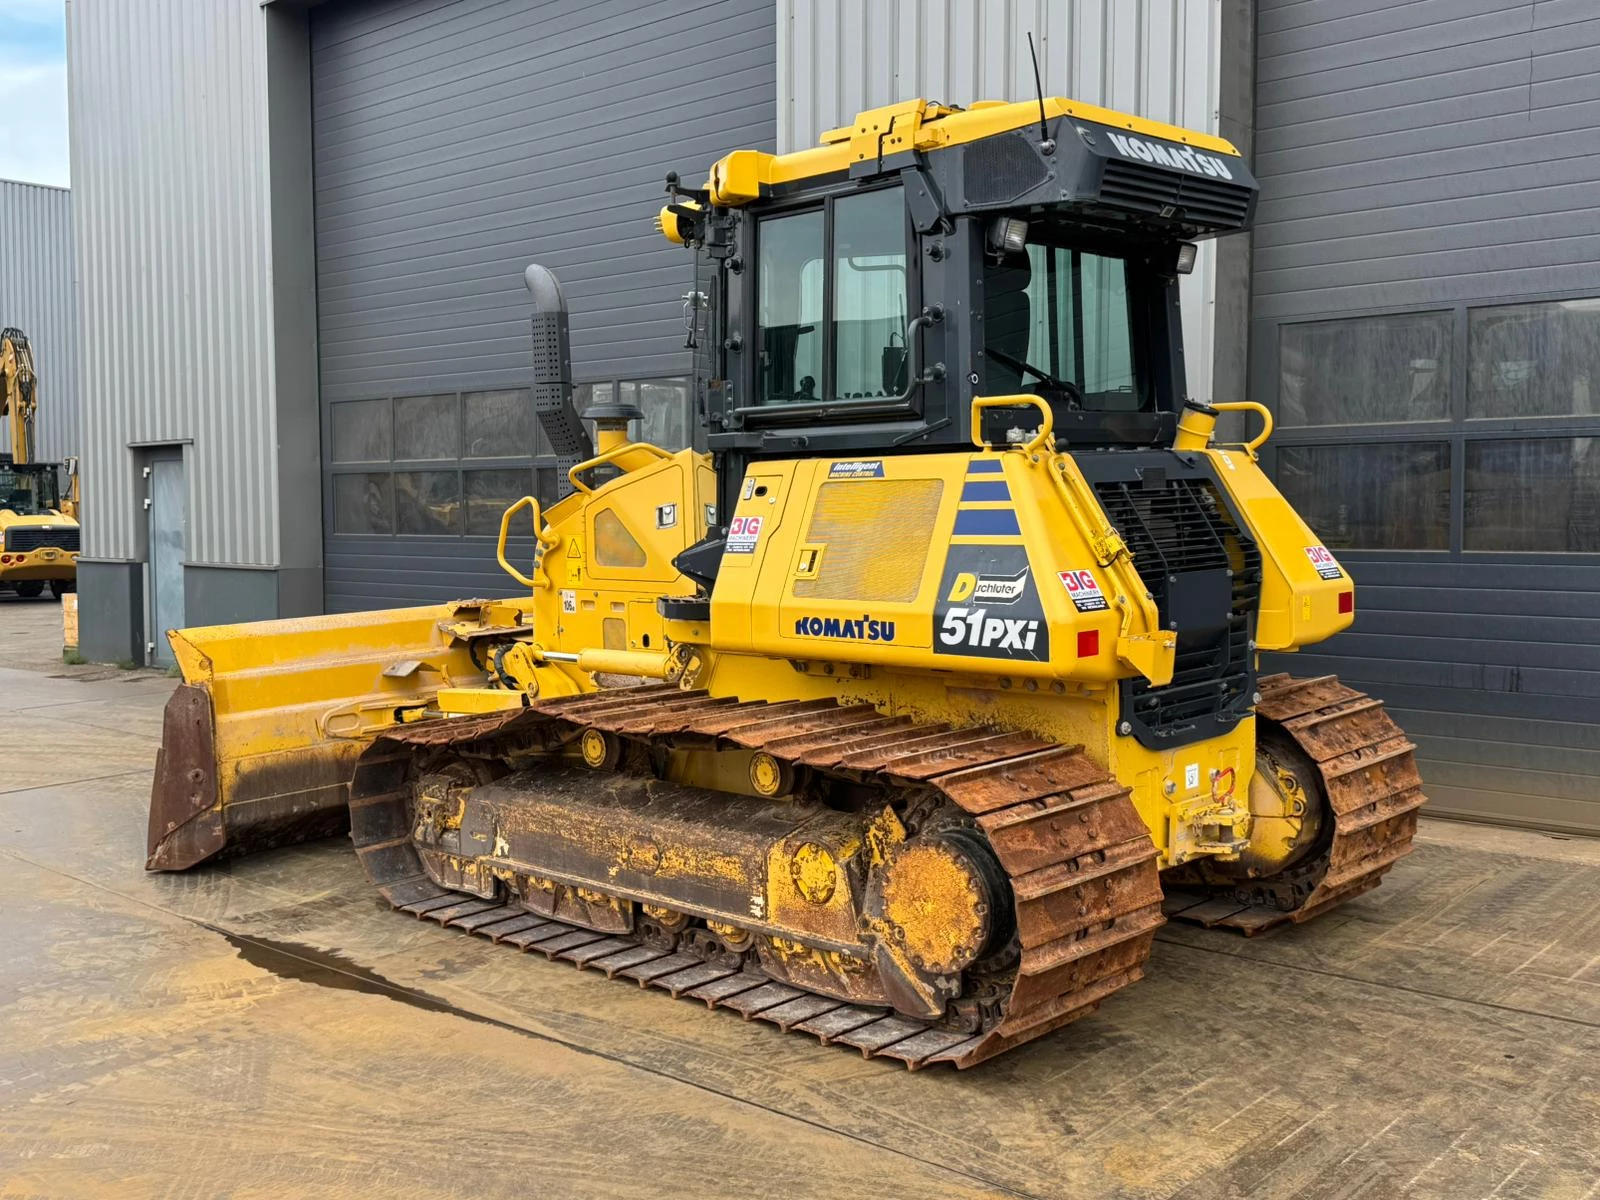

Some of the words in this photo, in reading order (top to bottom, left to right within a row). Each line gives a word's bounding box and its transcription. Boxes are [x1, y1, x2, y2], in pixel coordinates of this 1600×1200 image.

[1106, 131, 1233, 180] KOMATSU
[833, 461, 880, 473] Intelligent
[795, 614, 895, 642] KOMATSU
[939, 607, 1039, 650] 51PXi
